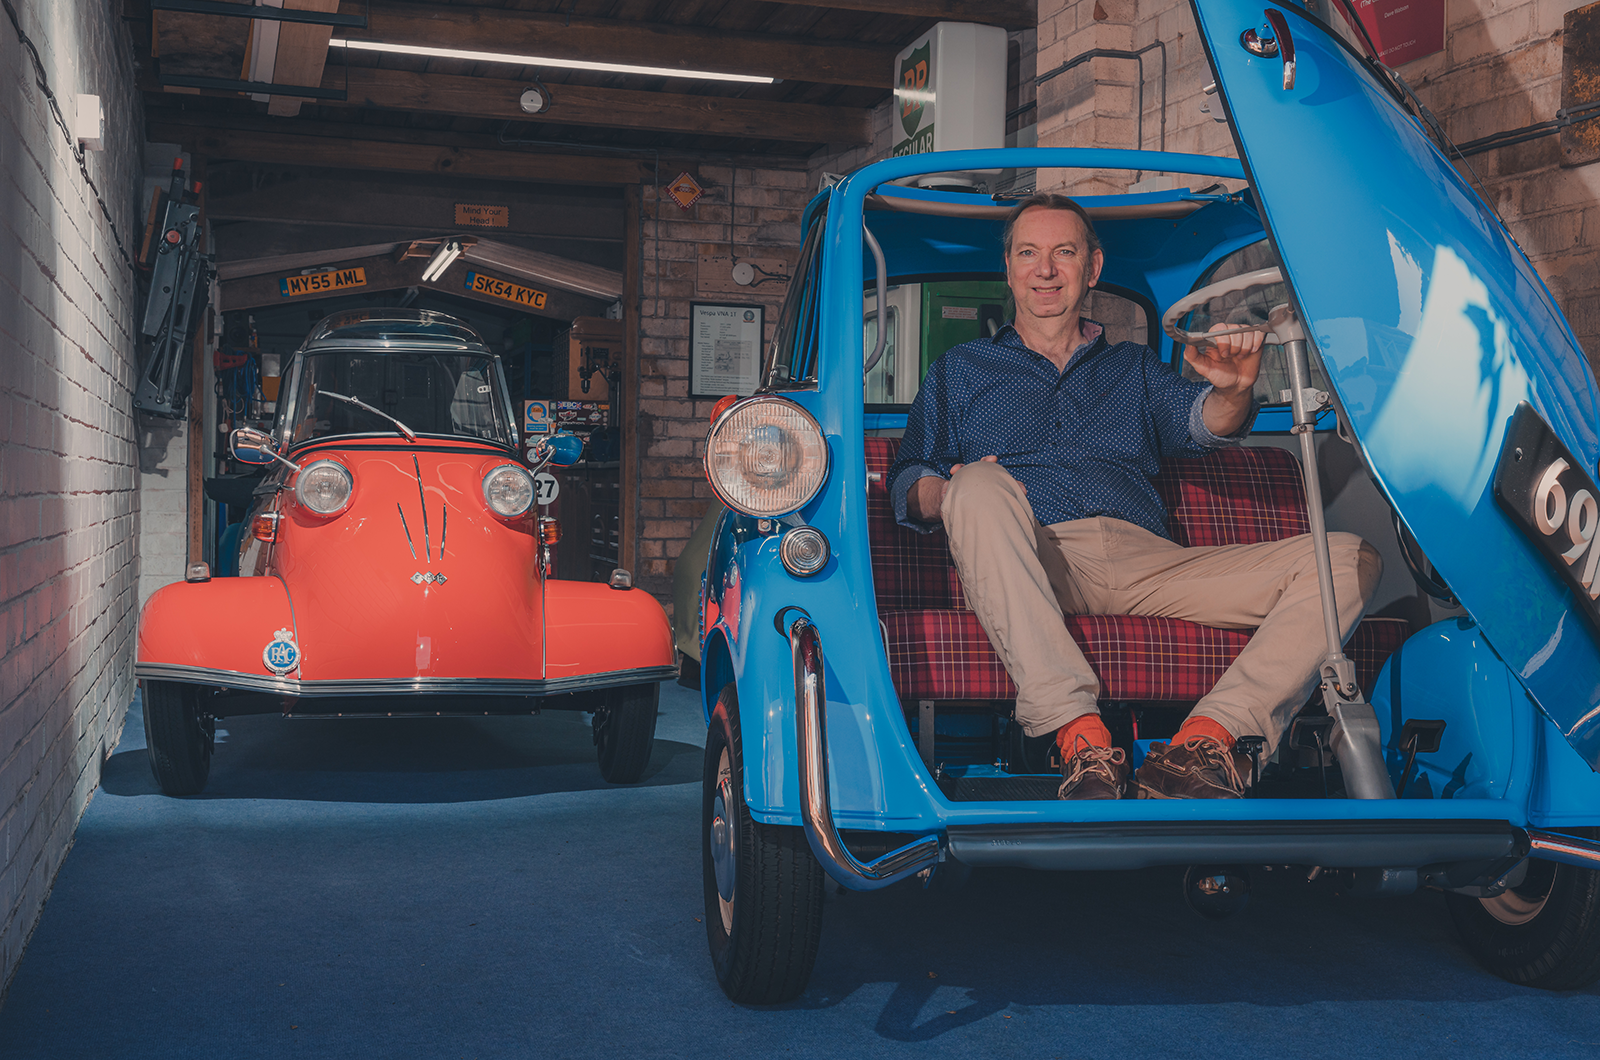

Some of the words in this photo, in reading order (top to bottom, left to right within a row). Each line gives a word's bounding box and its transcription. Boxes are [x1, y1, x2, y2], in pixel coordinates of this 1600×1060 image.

[1403, 39, 1416, 48] TOUCH
[902, 60, 927, 119] BP
[463, 206, 481, 215] Mind
[483, 207, 502, 216] Your
[469, 216, 490, 224] Head
[290, 274, 330, 293] MY55
[335, 270, 363, 286] AML
[475, 276, 513, 298] SK54
[515, 287, 544, 306] KYC
[699, 309, 716, 317] Vespa
[270, 643, 294, 664] RAC
